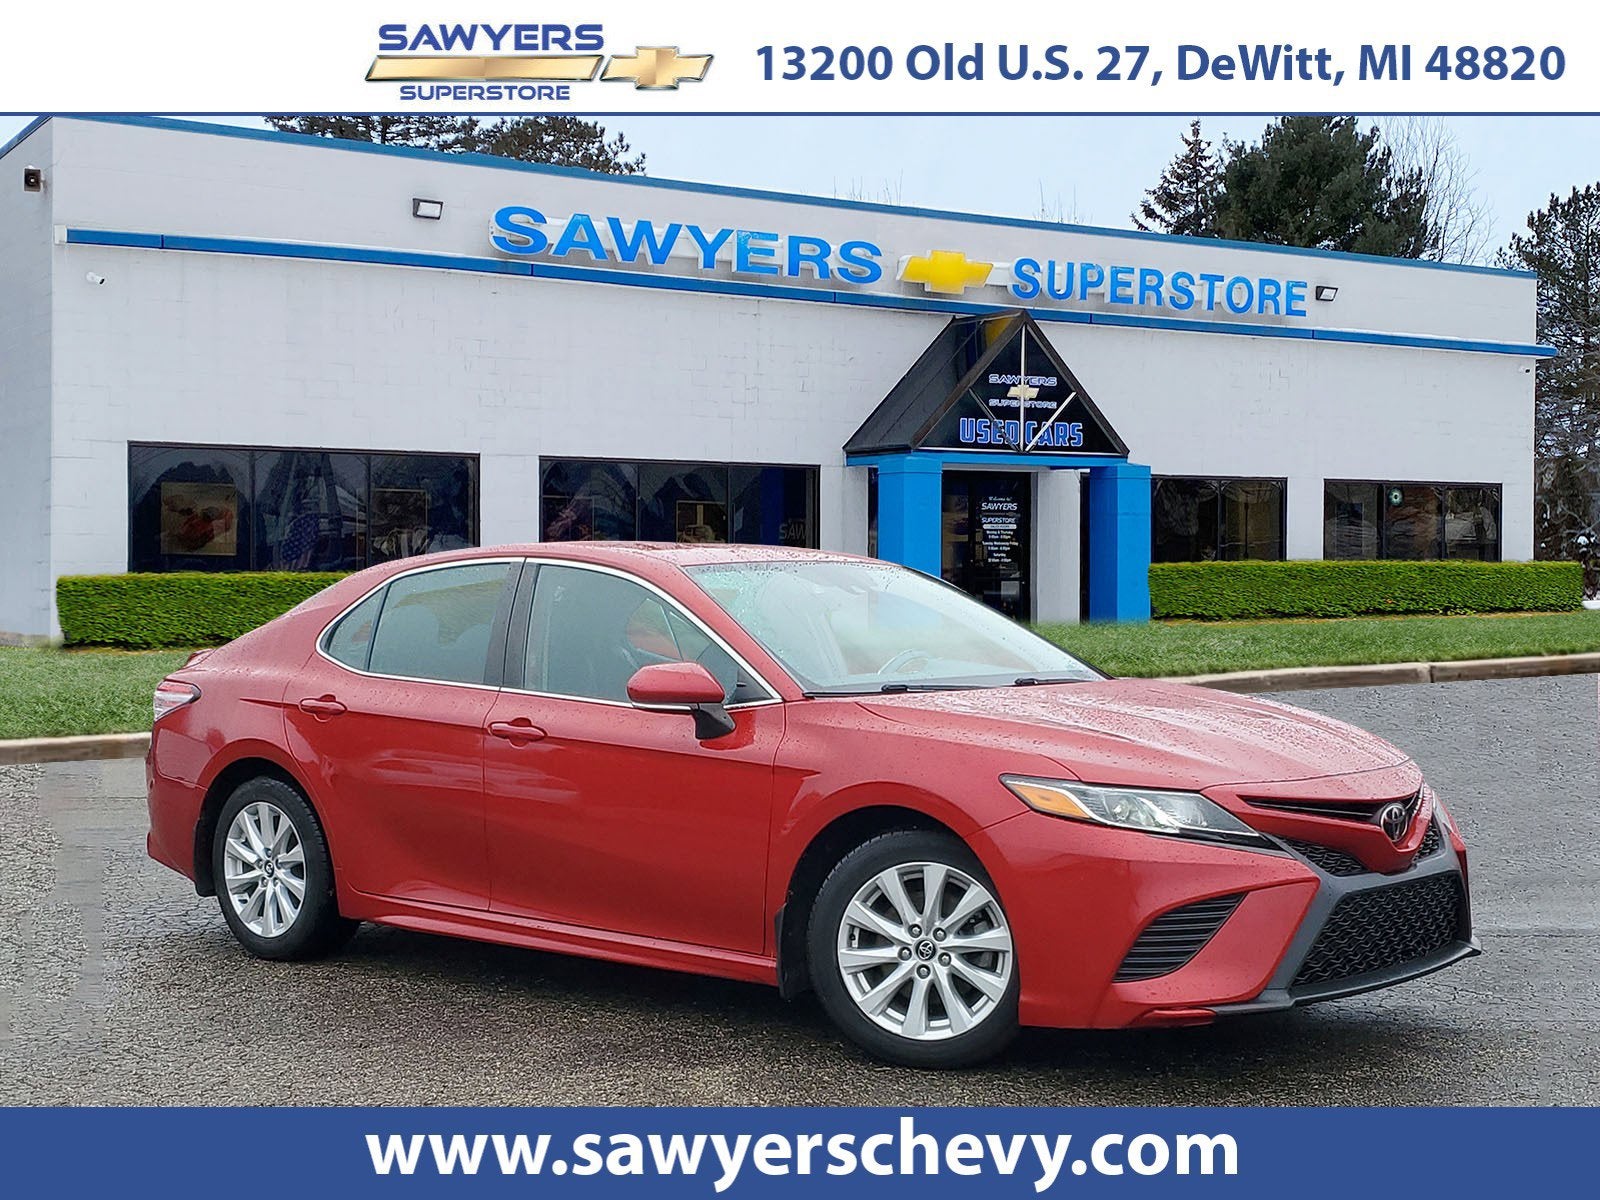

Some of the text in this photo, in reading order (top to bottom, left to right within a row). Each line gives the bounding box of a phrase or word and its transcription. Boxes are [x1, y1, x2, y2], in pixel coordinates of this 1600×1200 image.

[491, 206, 882, 284] SAWYERS
[1011, 258, 1308, 317] SUPERSTORE
[988, 374, 1058, 387] SAWYERS
[959, 418, 1083, 447] USED CARS
[981, 502, 1018, 511] SAWYERS
